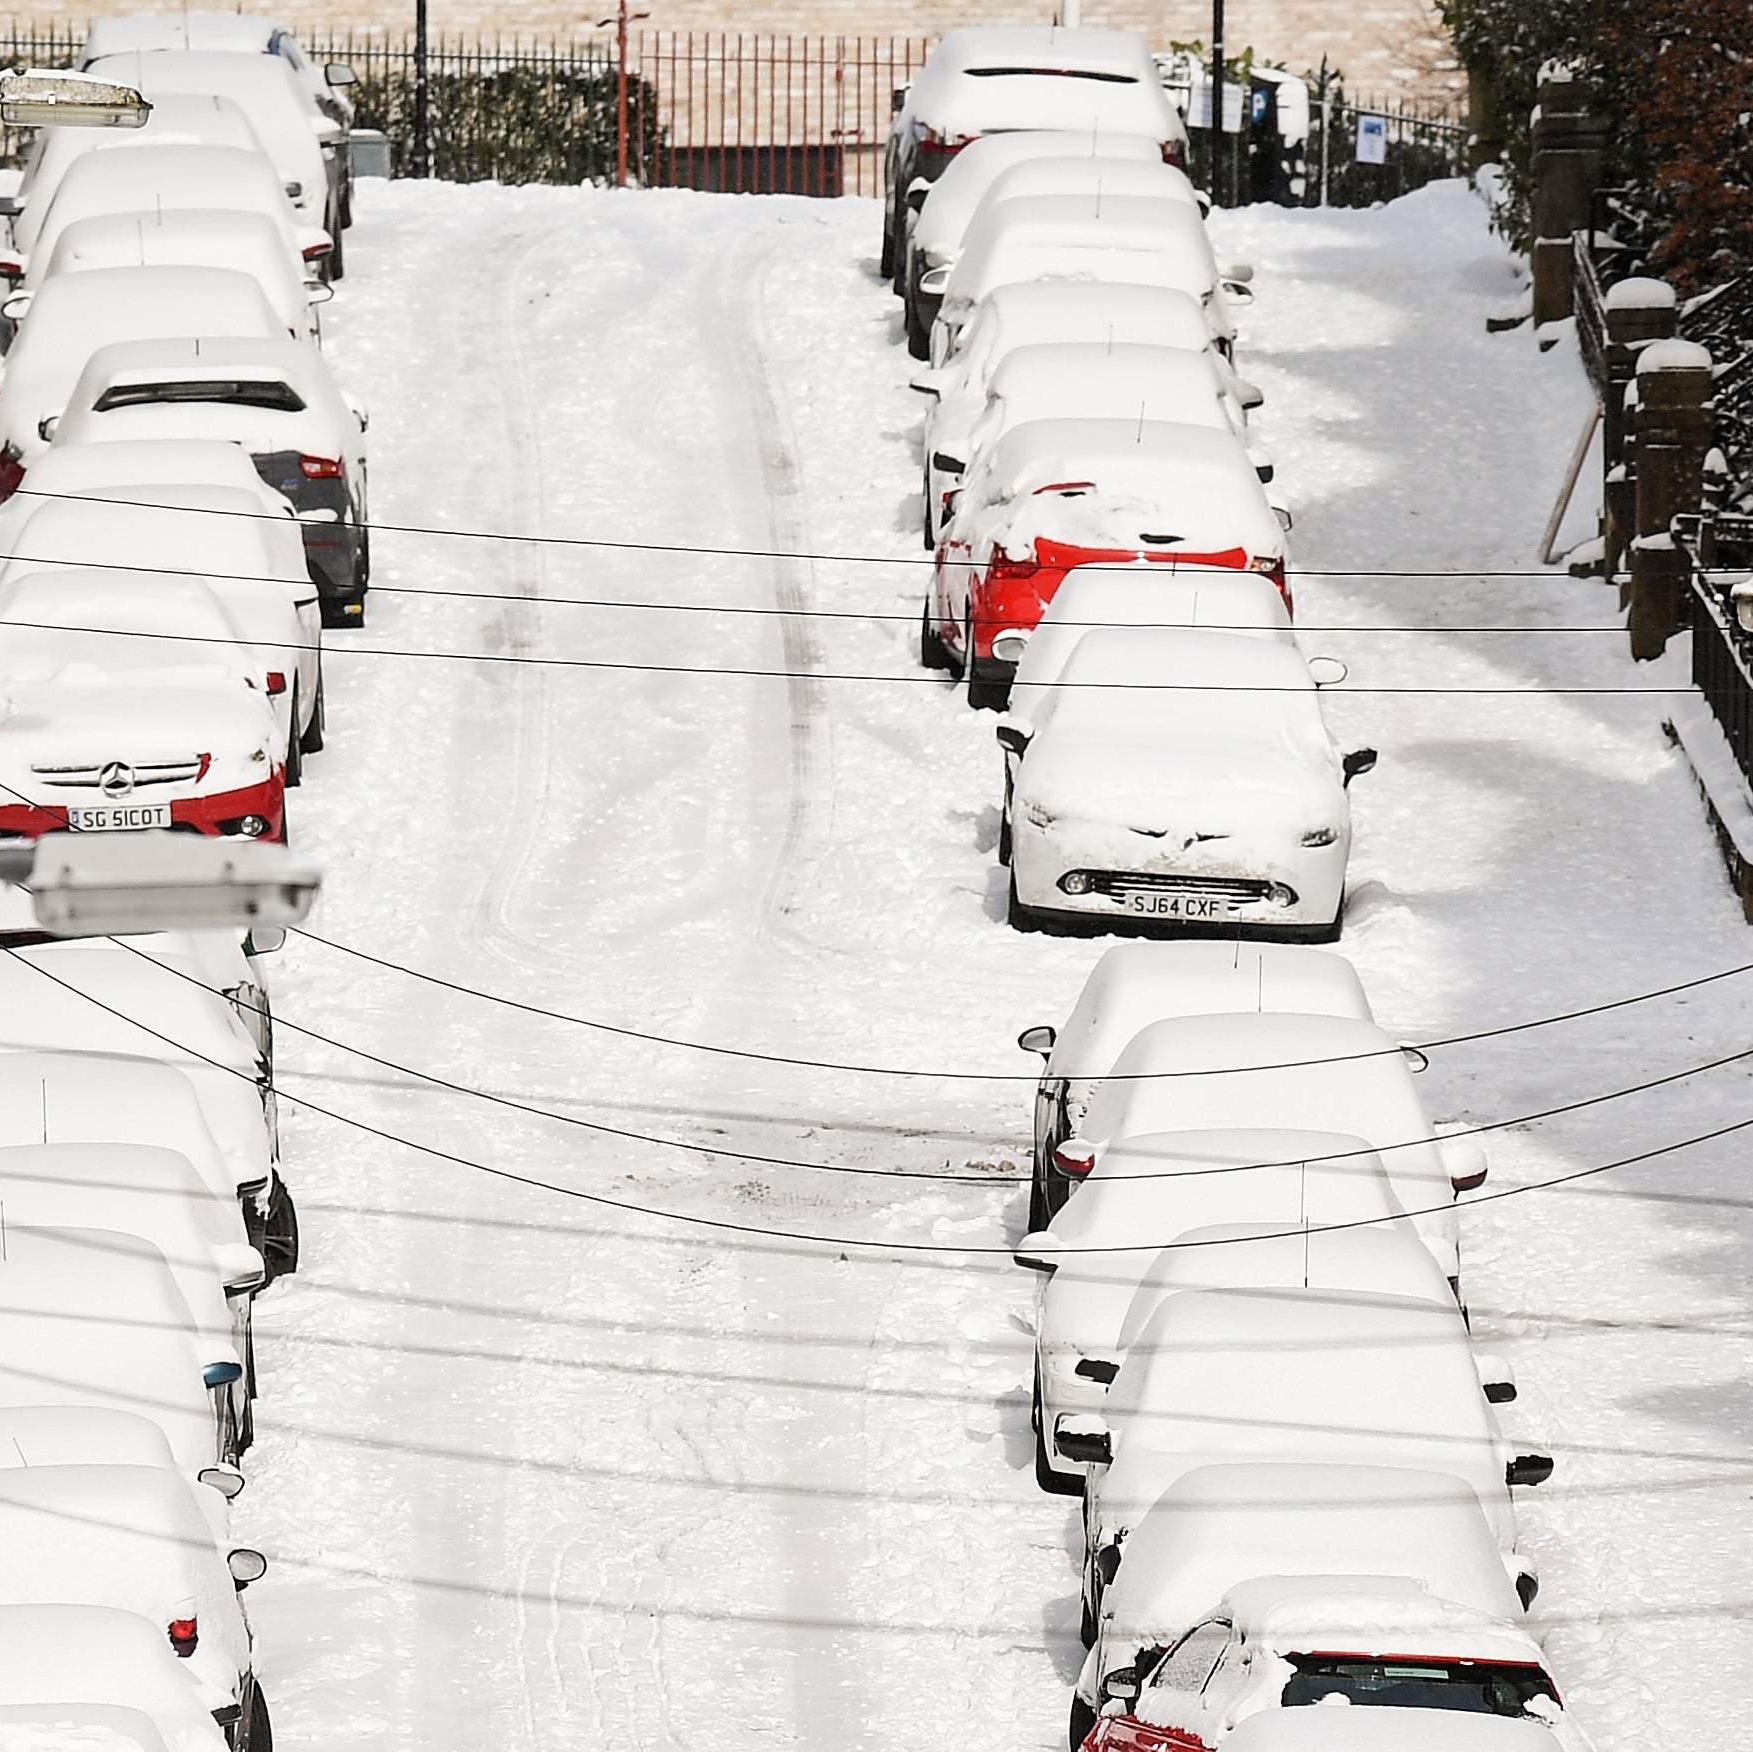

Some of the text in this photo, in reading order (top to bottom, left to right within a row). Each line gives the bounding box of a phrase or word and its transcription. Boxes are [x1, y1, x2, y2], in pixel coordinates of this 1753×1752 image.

[83, 811, 107, 828] SG
[1134, 896, 1220, 917] SJ64 CXF
